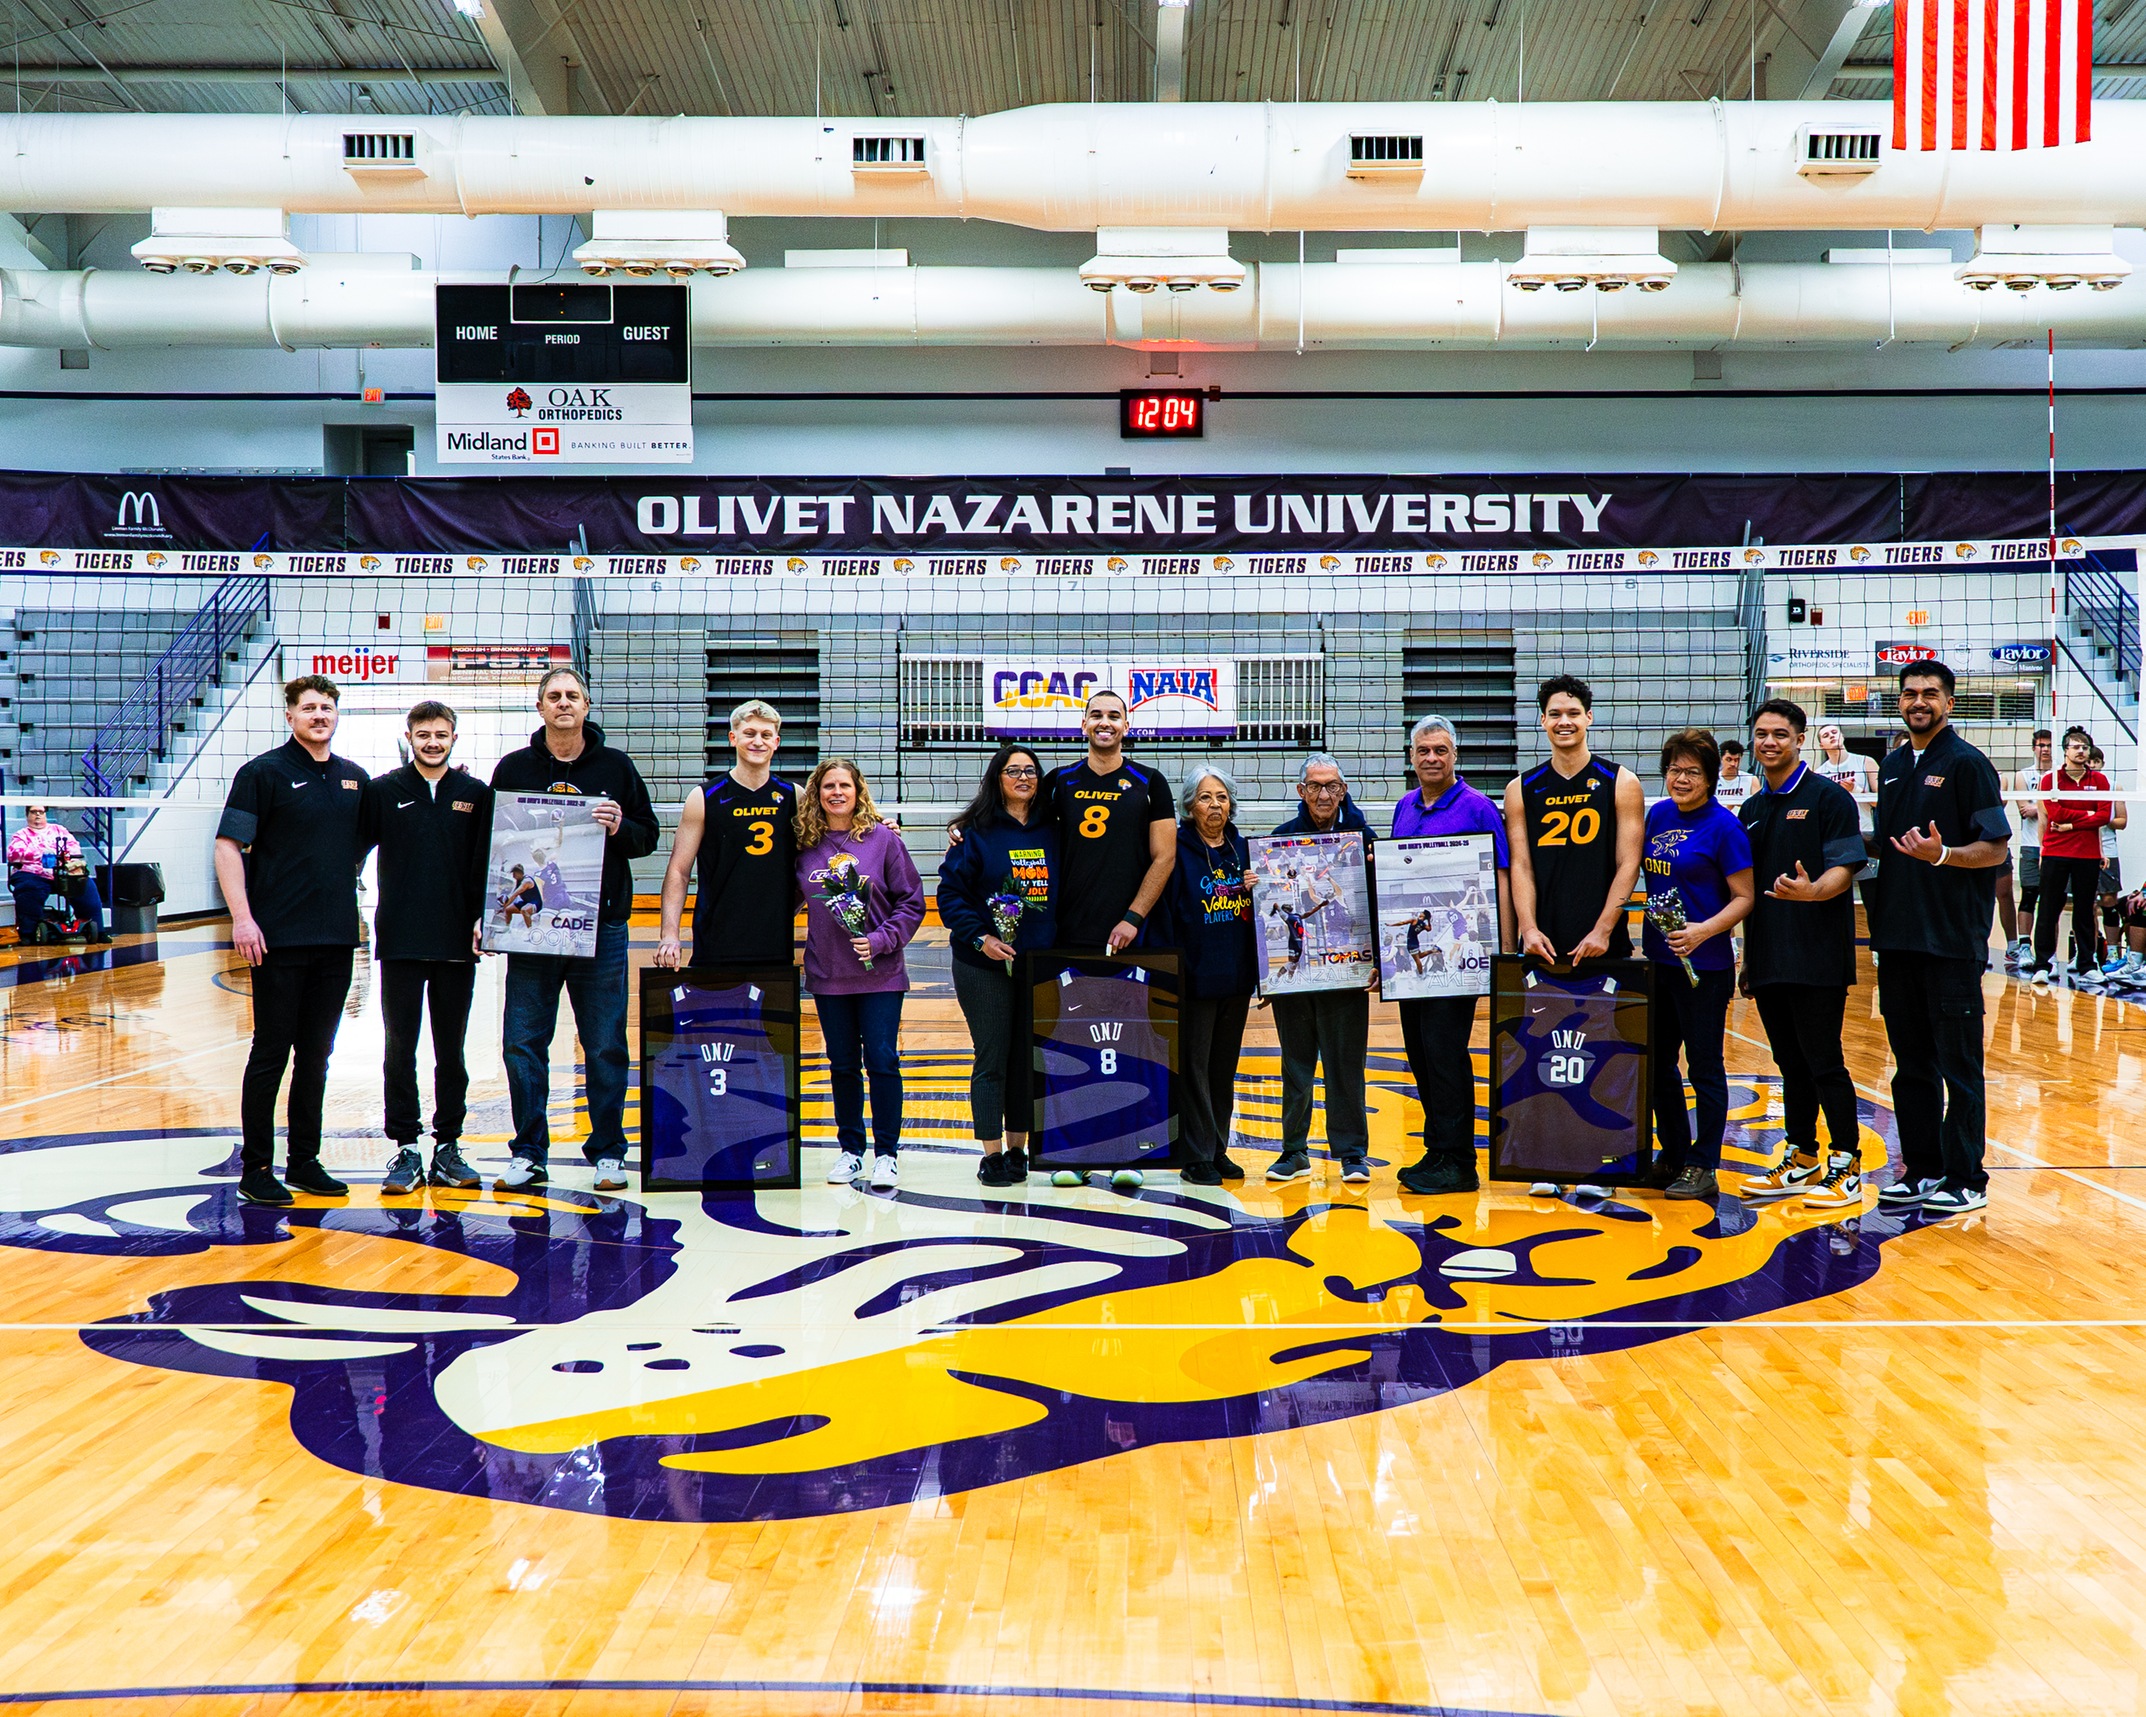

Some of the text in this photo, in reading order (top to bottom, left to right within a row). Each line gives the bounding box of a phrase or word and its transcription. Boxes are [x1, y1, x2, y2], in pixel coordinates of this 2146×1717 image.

[456, 326, 498, 340] HOME
[545, 334, 580, 345] PERIOD
[623, 326, 670, 341] GUEST
[548, 388, 612, 407] OAK
[538, 408, 623, 421] ORTHOPEDICS
[447, 431, 527, 451] Midland
[491, 453, 511, 461] States
[637, 493, 1614, 535] OLIVET NAZARENE UNIVERSITY
[74, 553, 133, 569] TIGERS
[182, 555, 240, 572] TIGERS
[288, 556, 346, 573] TIGERS
[394, 557, 454, 573] TIGERS
[501, 557, 560, 574] TIGERS
[608, 557, 666, 575] TIGERS
[714, 558, 774, 575] TIGERS
[821, 559, 880, 576] TIGERS
[928, 558, 987, 575] TIGERS
[1035, 558, 1093, 575] TIGERS
[1141, 557, 1200, 574] TIGERS
[1248, 557, 1307, 574] TIGERS
[1354, 556, 1413, 573] TIGERS
[1460, 554, 1519, 571] TIGERS
[1566, 553, 1625, 570] TIGERS
[1672, 551, 1731, 568] TIGERS
[1778, 549, 1837, 566] TIGERS
[1885, 546, 1943, 563] TIGERS
[1991, 542, 2048, 560] TIGERS
[1909, 610, 1927, 625] EXIT
[457, 653, 545, 669] PSI
[1789, 648, 1850, 659] RIVERSIDE
[1883, 646, 1931, 663] Taylor
[1996, 646, 2043, 664] Taylor
[312, 647, 398, 681] meijer
[993, 670, 1098, 708] CCAC
[1130, 670, 1217, 708] NAIA
[1074, 789, 1122, 802] OLIVET
[1544, 793, 1591, 806] OLIVET
[733, 806, 779, 817] OLIVET
[1078, 805, 1111, 839] 8
[1537, 807, 1602, 847] 20
[744, 821, 775, 856] 3
[1422, 841, 1449, 849] VOLLEYBALL
[1644, 856, 1671, 877] ONU
[551, 916, 595, 931] CADE
[1204, 910, 1235, 925] PLAYERS
[528, 927, 594, 949] OOMS
[1319, 949, 1373, 965] TOMAS
[1458, 957, 1490, 970] JOE
[1089, 1022, 1124, 1043] ONU
[1551, 1030, 1587, 1051] ONU
[700, 1042, 735, 1063] ONU
[1100, 1048, 1117, 1075] 8
[1550, 1055, 1586, 1084] 20
[709, 1068, 727, 1096] 3
